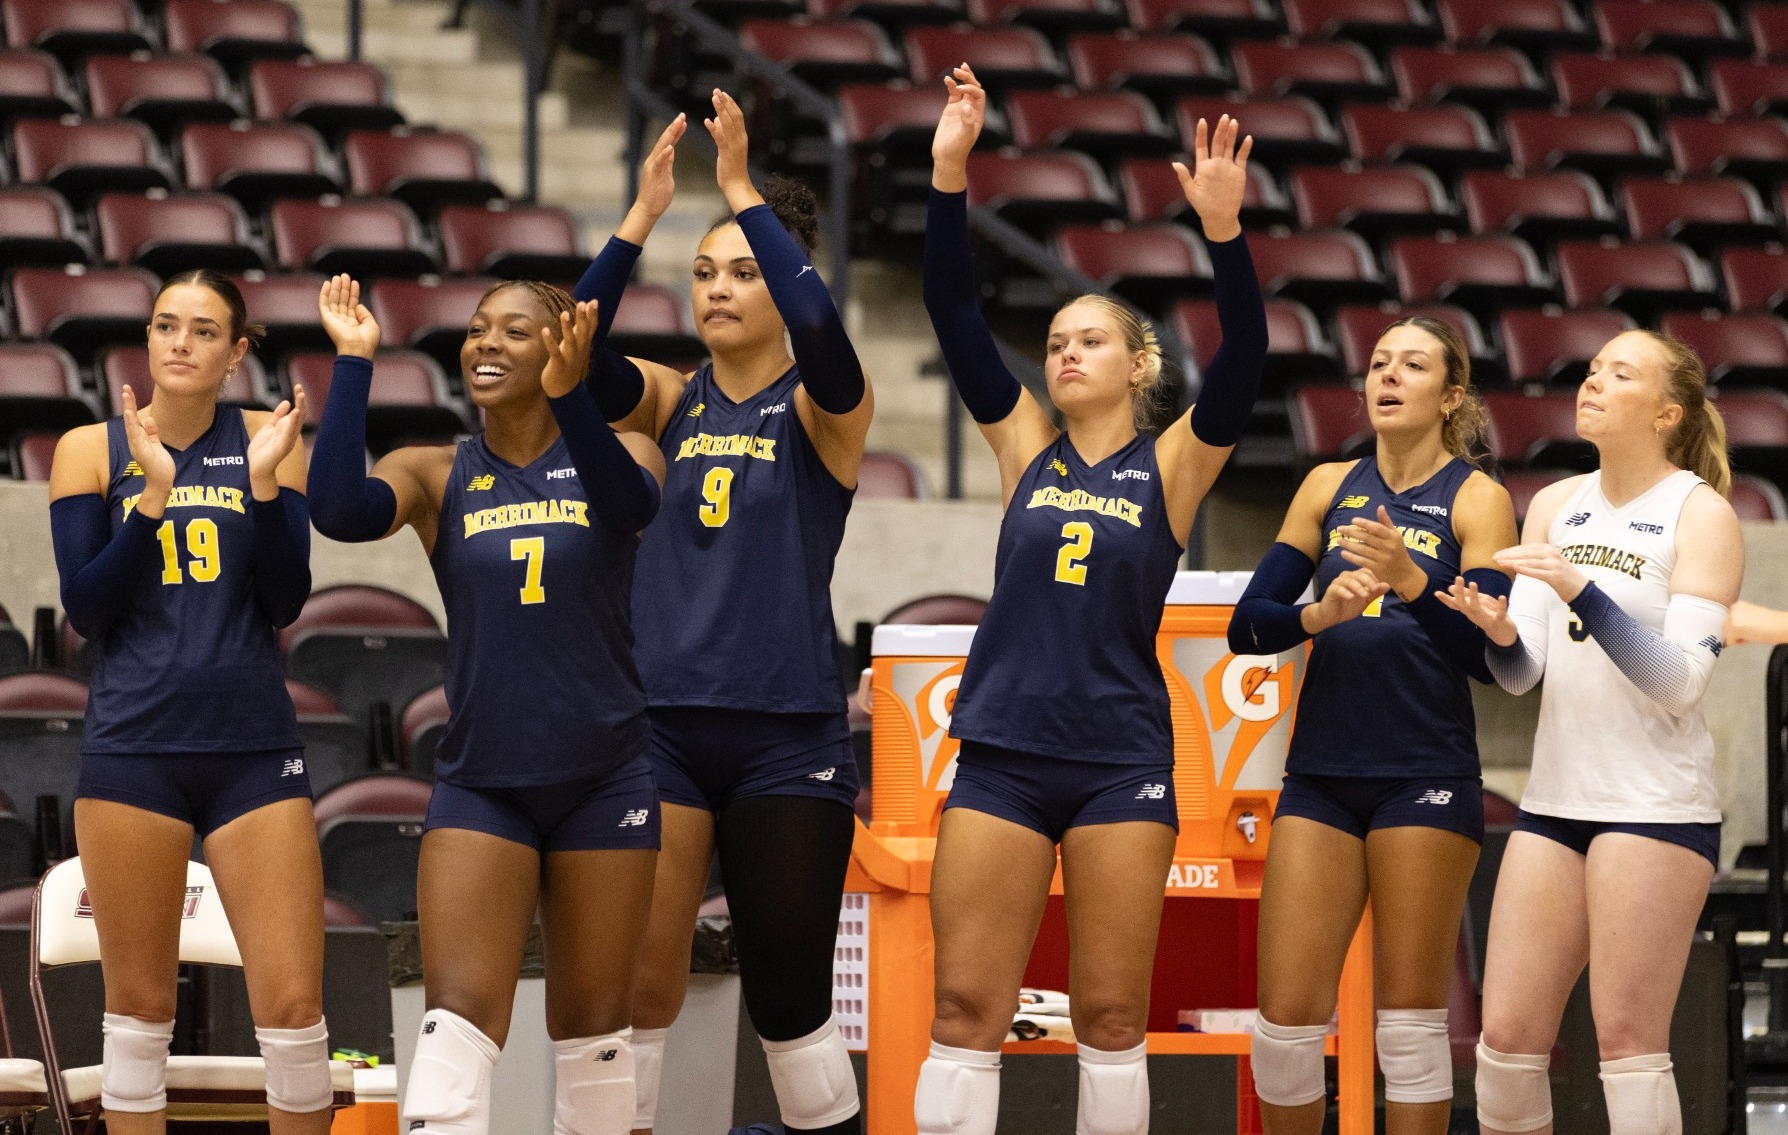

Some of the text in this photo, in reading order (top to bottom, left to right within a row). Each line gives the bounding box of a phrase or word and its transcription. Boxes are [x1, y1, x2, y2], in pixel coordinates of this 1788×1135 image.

[203, 456, 244, 467] METRO
[1112, 469, 1150, 481] METRO
[699, 466, 735, 528] 9
[1026, 486, 1143, 528] MERRIMACK
[1411, 504, 1448, 517] METRO
[463, 499, 590, 539] MERRIMACK
[1628, 520, 1664, 535] METRO
[156, 517, 221, 586] 19
[510, 536, 546, 605] 7
[1054, 520, 1094, 587] 2
[1221, 653, 1280, 722] G
